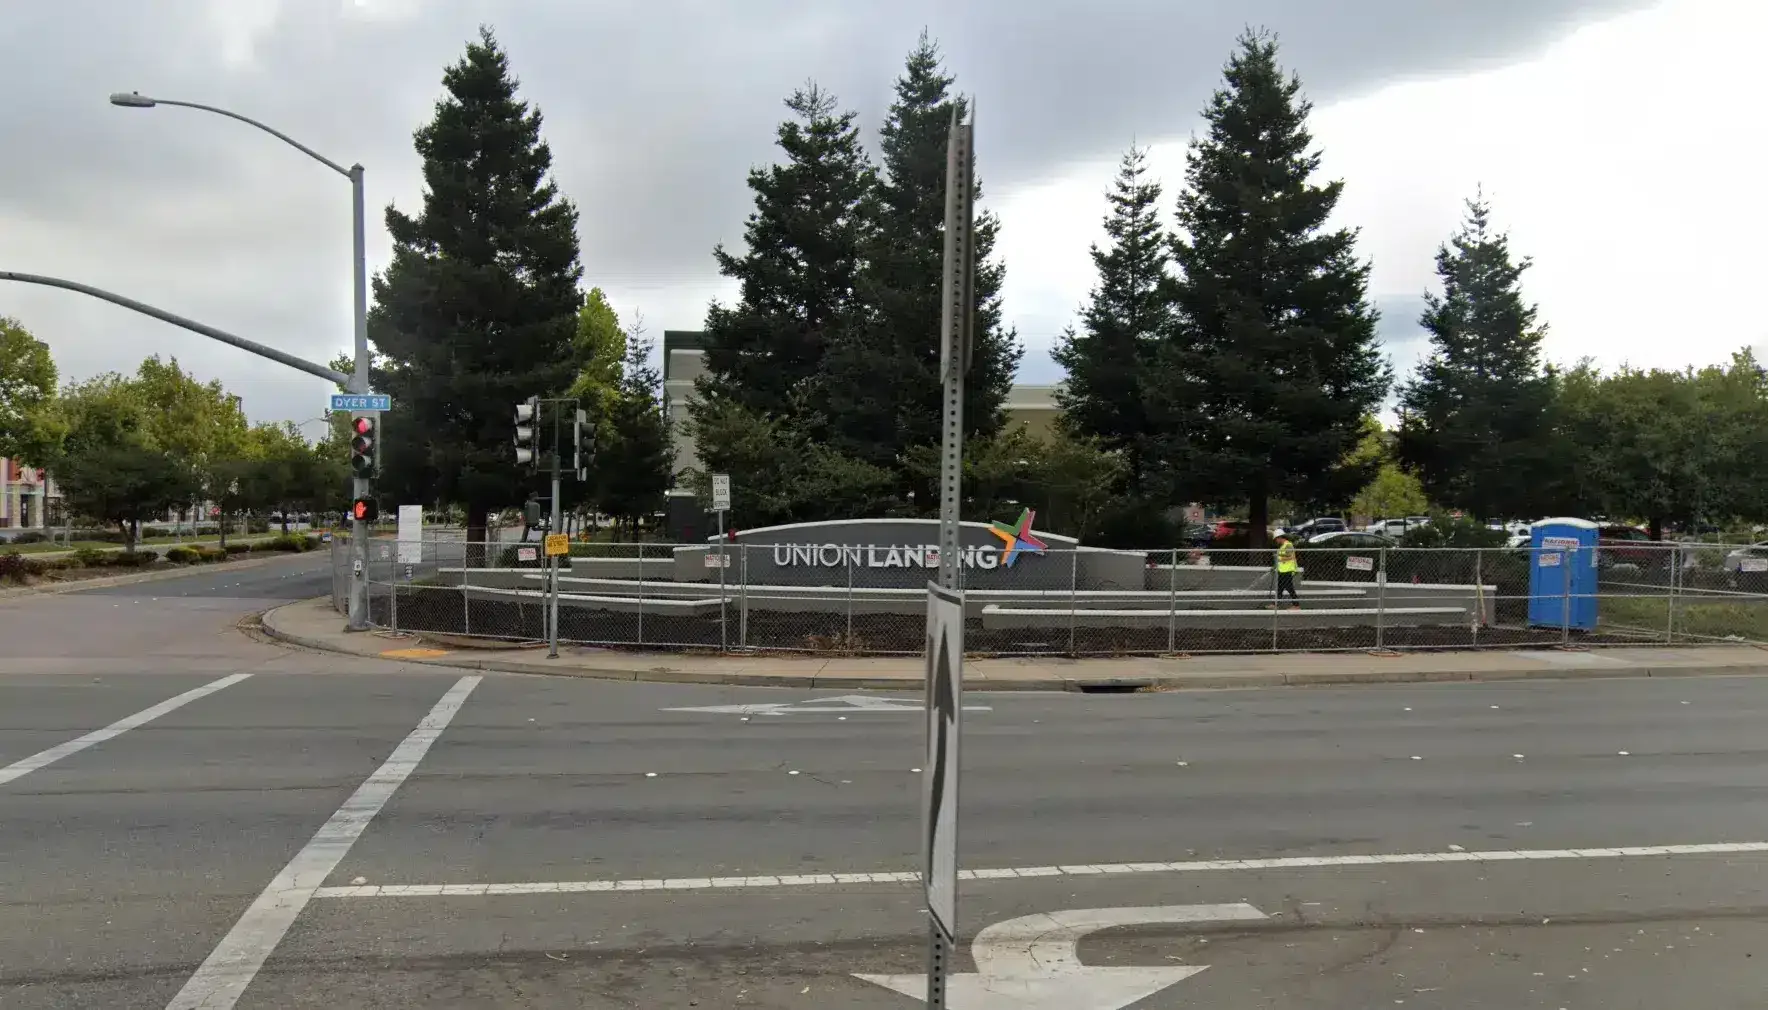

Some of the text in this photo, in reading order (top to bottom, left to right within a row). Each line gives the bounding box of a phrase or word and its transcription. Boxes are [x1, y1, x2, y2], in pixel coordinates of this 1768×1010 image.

[336, 398, 386, 409] DYER ST
[720, 477, 728, 485] NOT
[715, 488, 728, 496] BLOCK
[774, 543, 998, 569] UNION LANDNG
